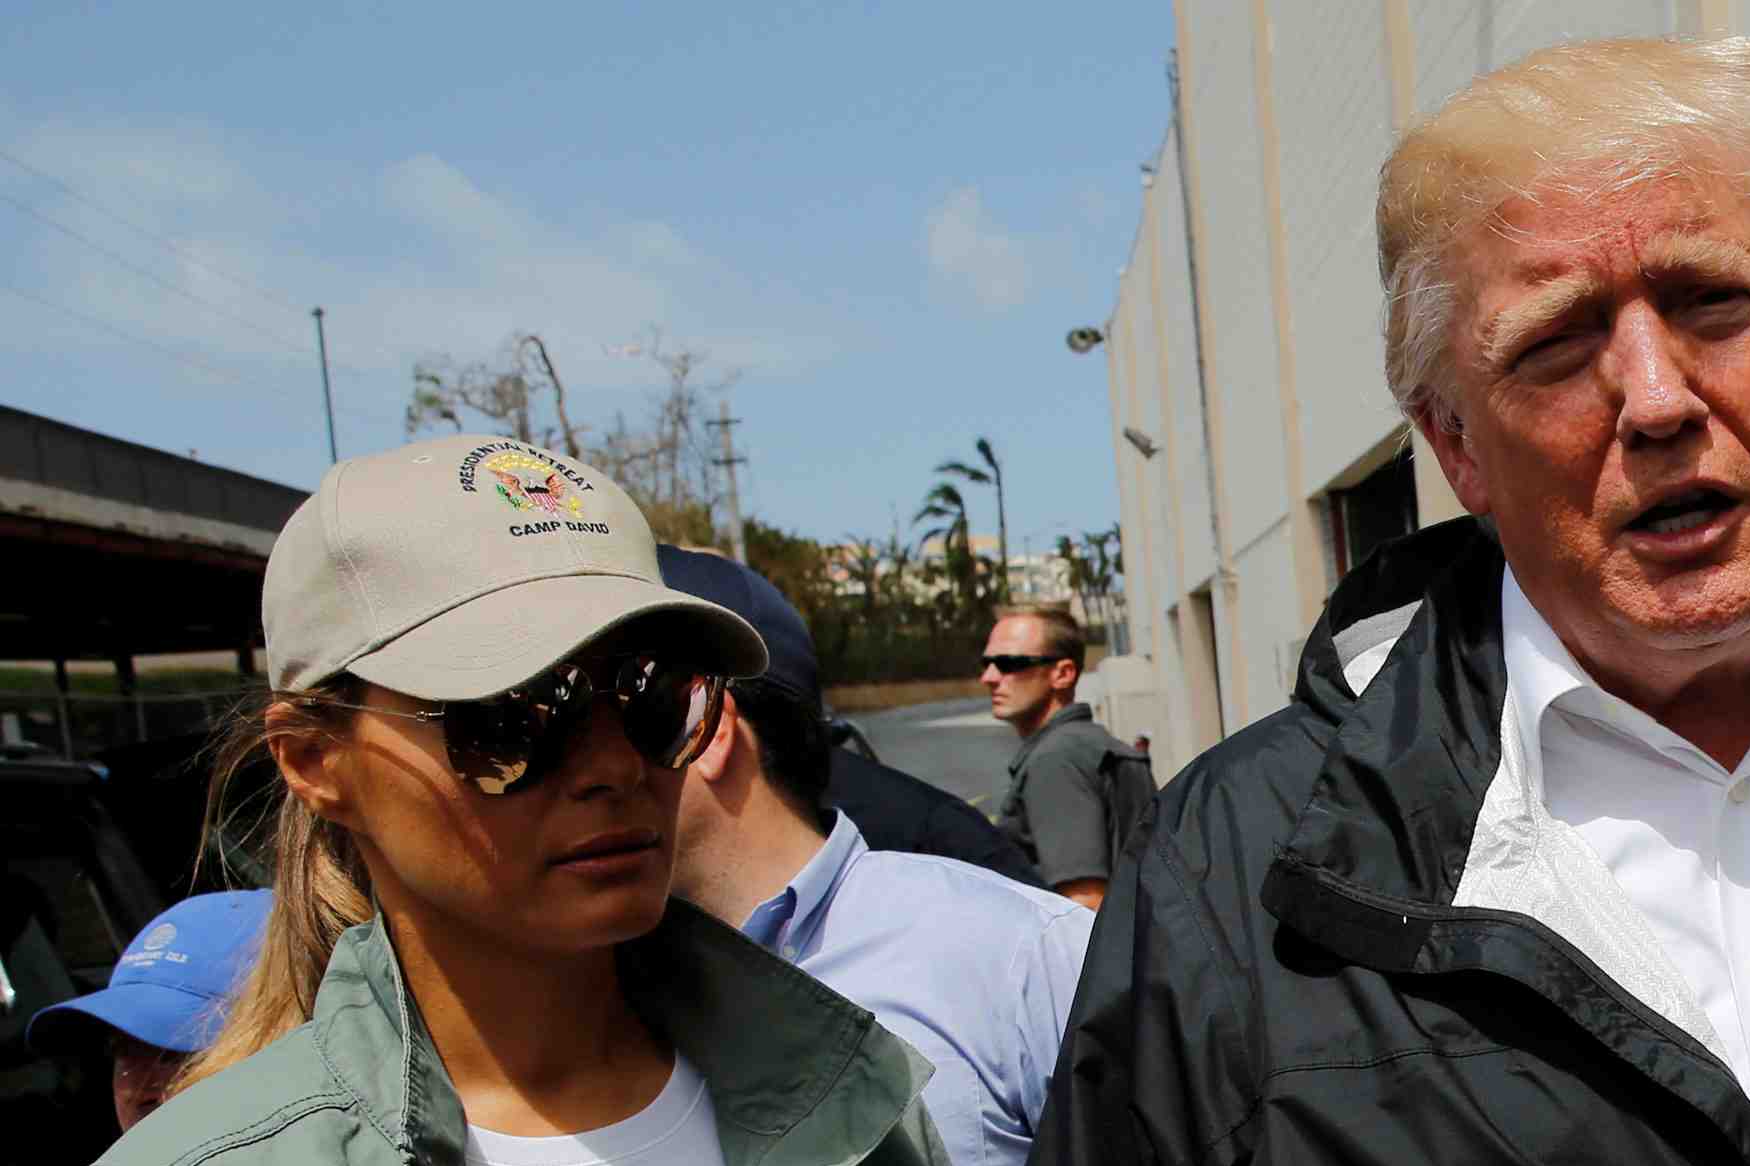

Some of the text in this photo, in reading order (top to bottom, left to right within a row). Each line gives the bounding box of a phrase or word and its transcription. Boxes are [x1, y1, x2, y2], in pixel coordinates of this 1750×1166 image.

[460, 442, 595, 492] PRESIDENTIAL RETREAT
[509, 520, 610, 537] CAMP DAVID
